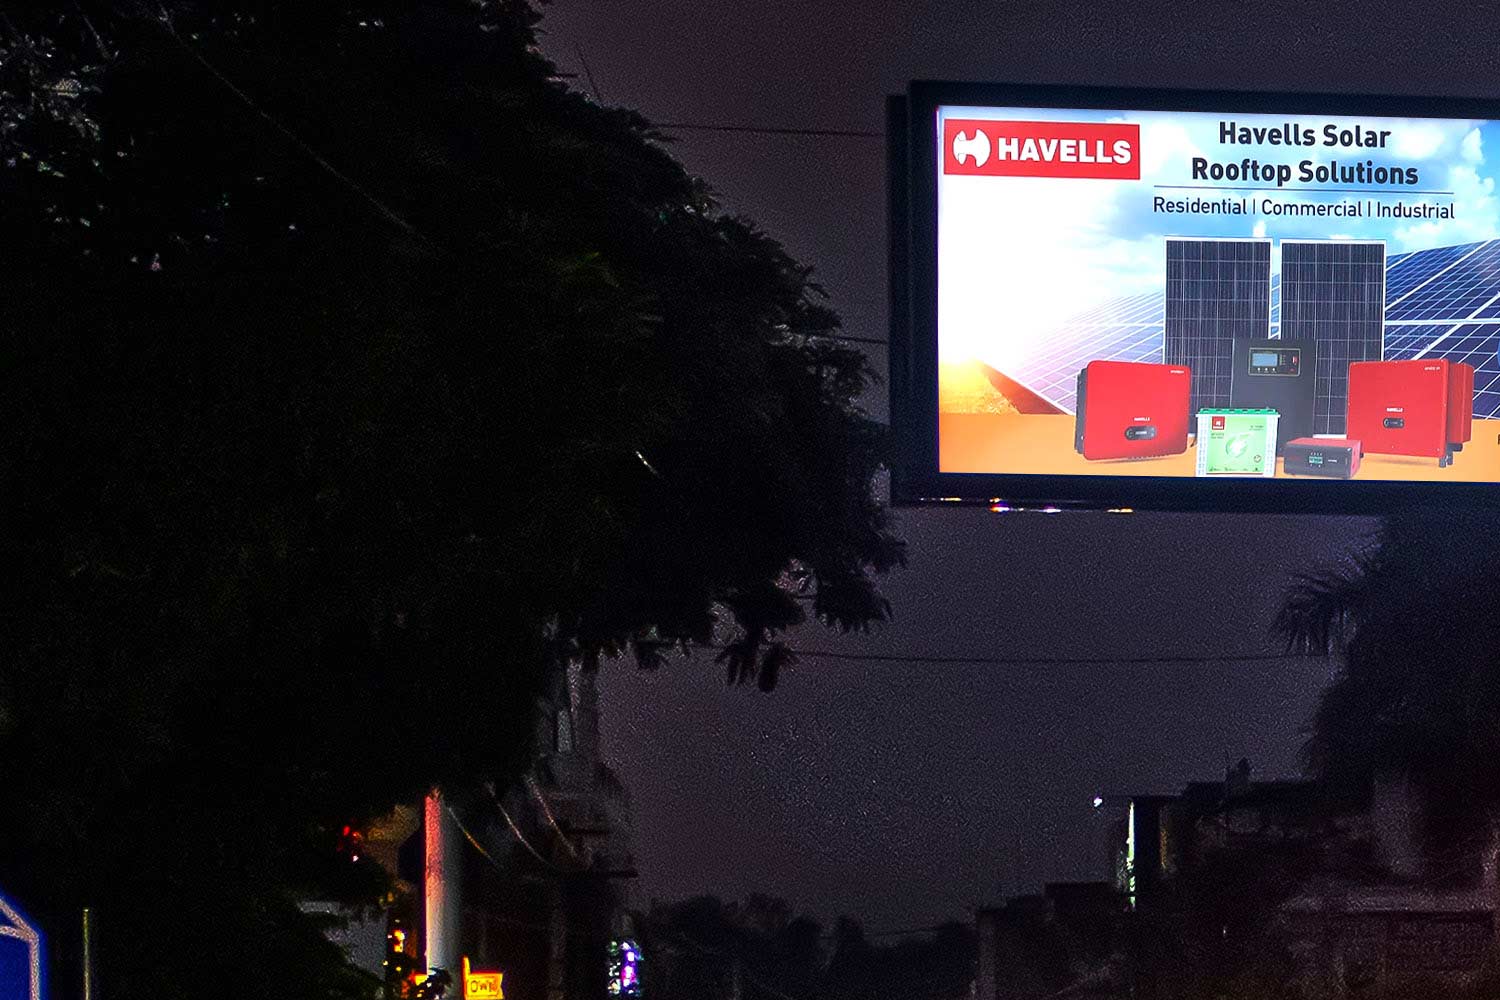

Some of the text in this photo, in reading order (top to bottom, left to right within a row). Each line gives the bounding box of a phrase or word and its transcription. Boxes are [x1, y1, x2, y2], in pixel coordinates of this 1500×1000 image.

[1219, 121, 1392, 148] Havells Solar
[998, 137, 1132, 164] HAVELLS
[1192, 157, 1419, 187] Rooftop Solutions
[1153, 196, 1248, 215] Residential
[1261, 199, 1363, 217] Commercial
[1376, 201, 1455, 219] Industrial
